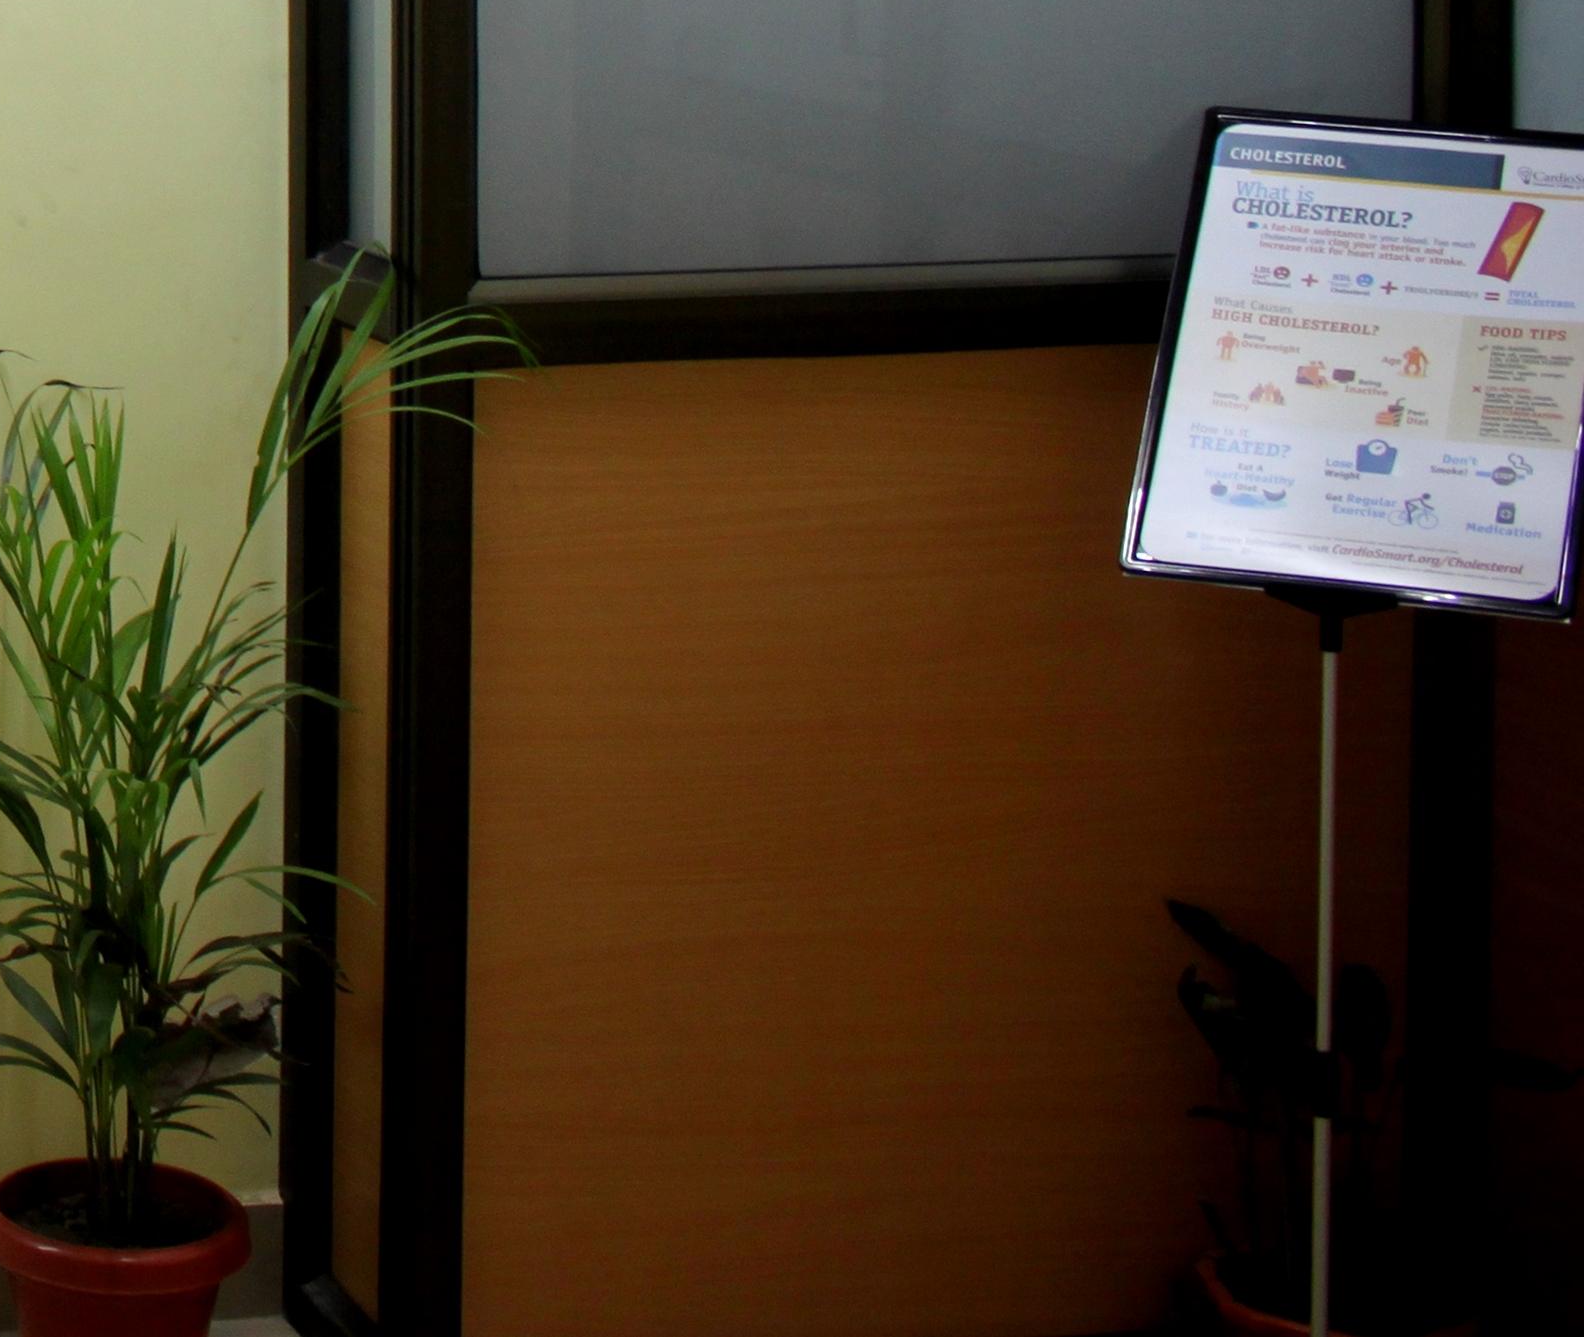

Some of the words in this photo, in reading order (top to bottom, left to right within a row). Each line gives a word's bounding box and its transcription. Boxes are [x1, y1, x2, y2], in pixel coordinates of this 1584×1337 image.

[1230, 147, 1346, 170] CHOLESTEROL
[1236, 180, 1288, 201] What
[1298, 185, 1315, 203] is
[1232, 197, 1413, 230] CHOLESTEROL?
[1313, 226, 1366, 239] substance
[1347, 249, 1375, 259] heart
[1378, 252, 1412, 262] attack
[1379, 244, 1421, 254] arteries
[1424, 247, 1444, 255] and
[1214, 296, 1246, 309] What
[1250, 299, 1294, 314] Causes
[1211, 308, 1253, 324] HIGH
[1259, 314, 1380, 337] CHOLESTEROL?
[1480, 325, 1524, 339] FOOD
[1529, 328, 1568, 342] TIPS
[1189, 434, 1292, 459] TREATED?
[1325, 457, 1355, 469] Lose
[1442, 453, 1479, 466] Don't
[1324, 468, 1361, 481] Weight
[1325, 492, 1343, 503] Get
[1346, 493, 1398, 508] Regular
[1332, 504, 1386, 520] Exercise
[1466, 522, 1542, 539] Medication
[1331, 543, 1525, 576] CardioSmart.org/Cholesterol
